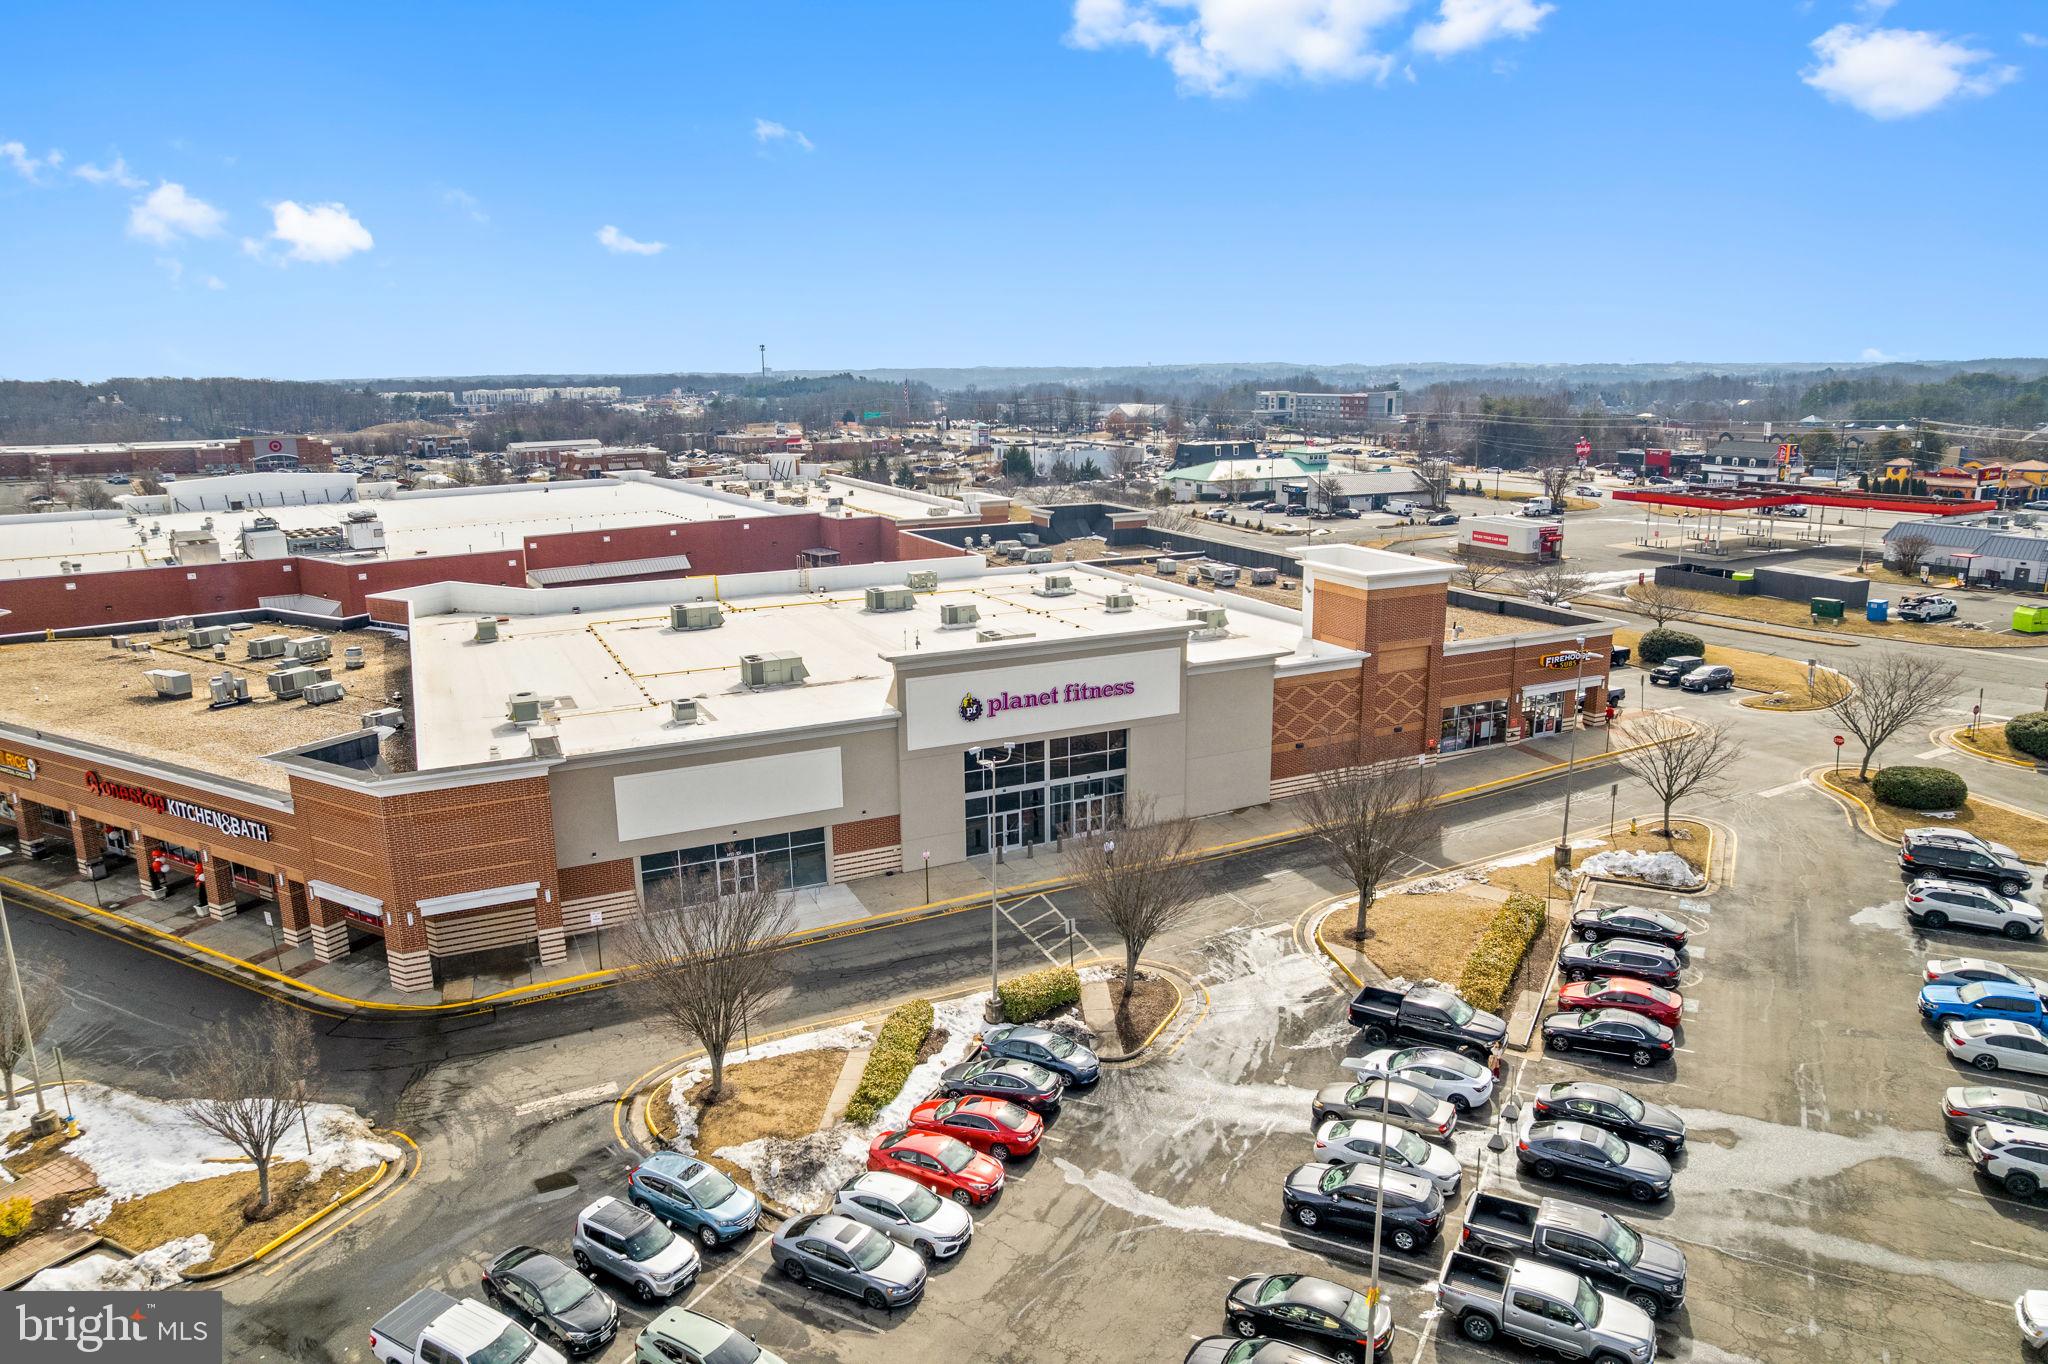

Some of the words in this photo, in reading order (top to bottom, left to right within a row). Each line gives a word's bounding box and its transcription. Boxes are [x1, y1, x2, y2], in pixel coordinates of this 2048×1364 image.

[1560, 660, 1577, 668] SUBS
[966, 706, 977, 717] pf
[987, 686, 1058, 718] planet
[1064, 681, 1135, 702] fitness
[99, 780, 165, 814] onestop
[167, 799, 268, 842] KITCHEN&BATH
